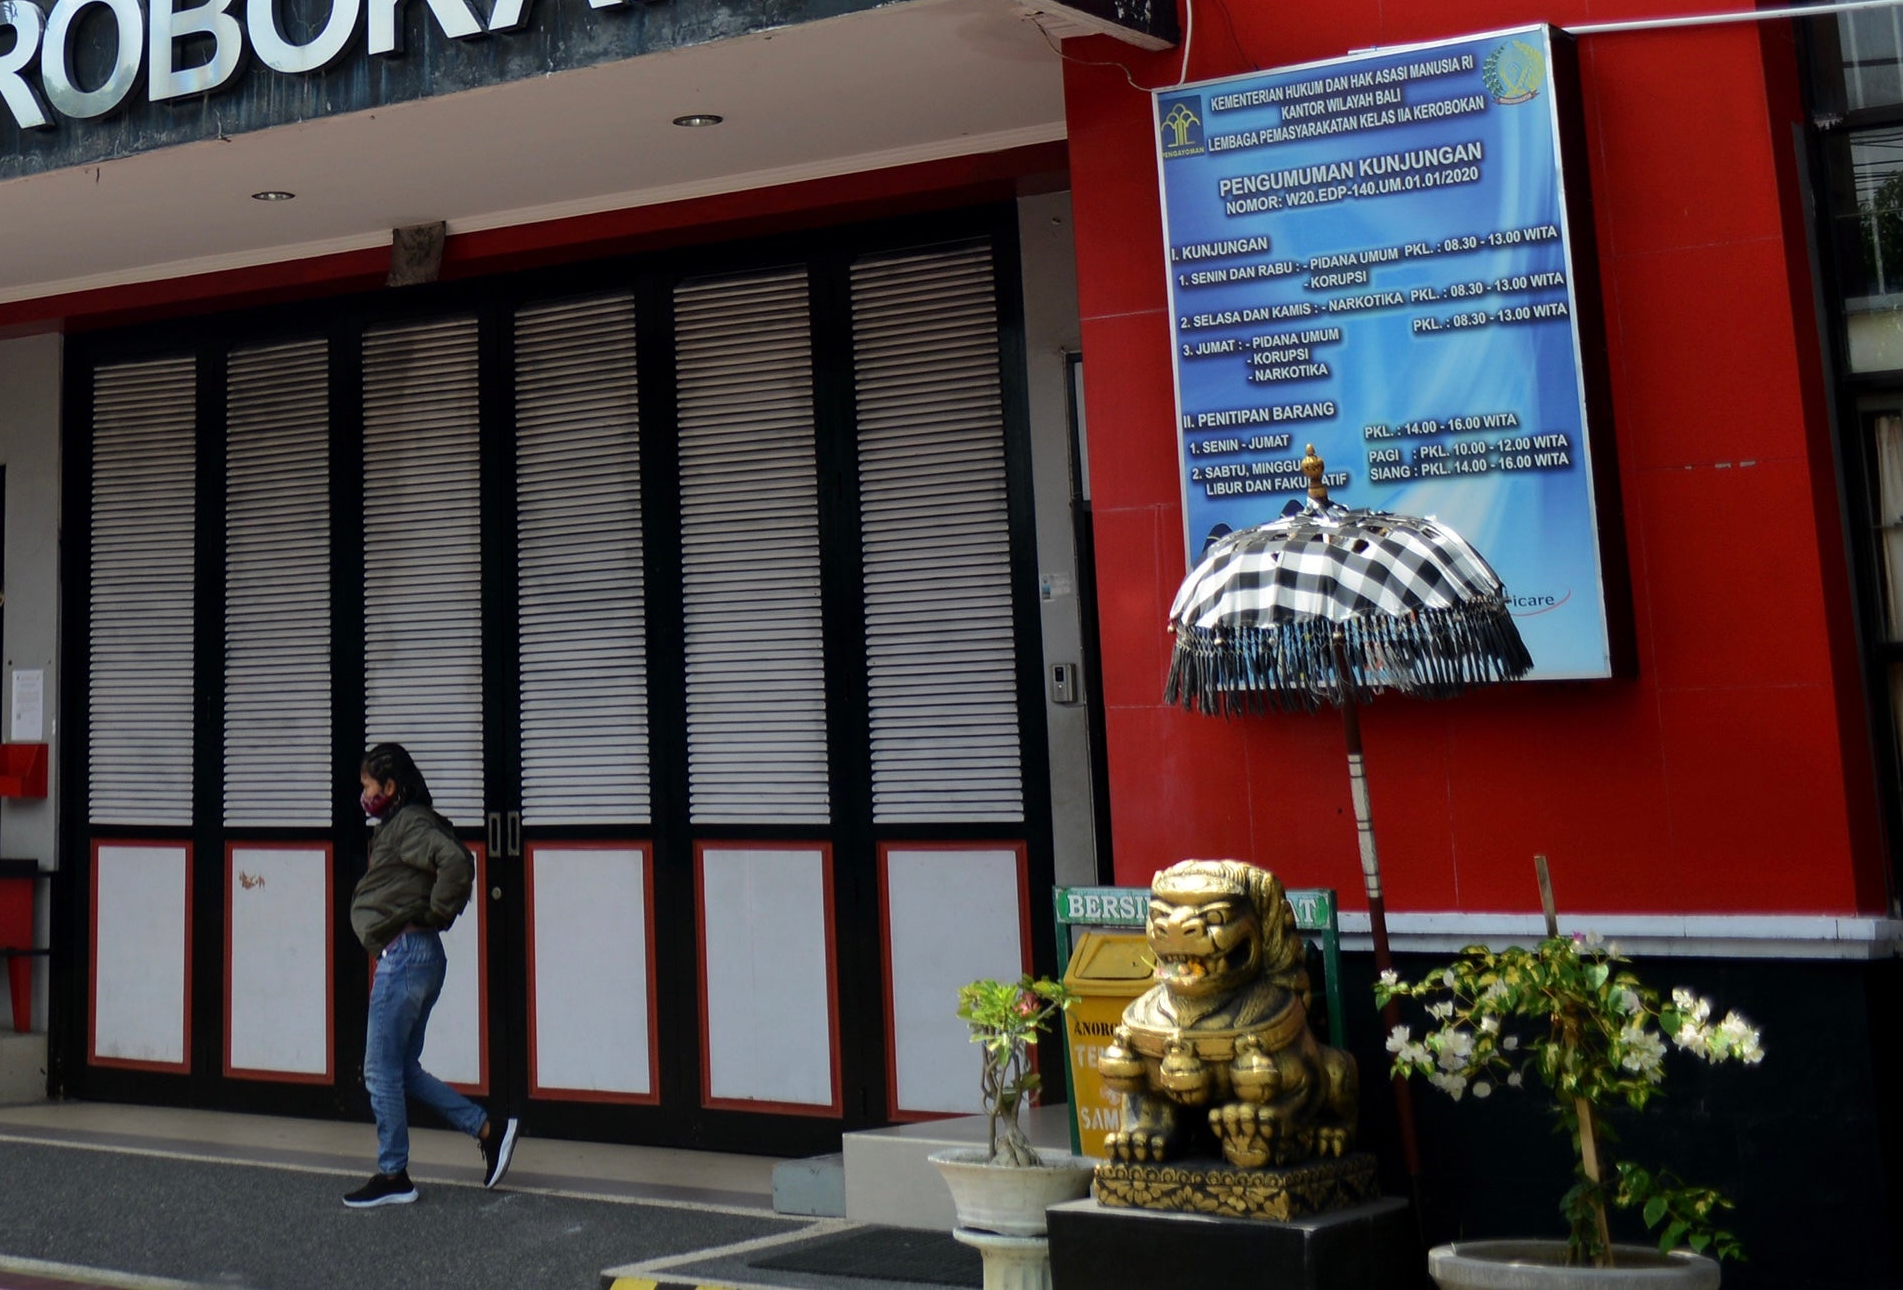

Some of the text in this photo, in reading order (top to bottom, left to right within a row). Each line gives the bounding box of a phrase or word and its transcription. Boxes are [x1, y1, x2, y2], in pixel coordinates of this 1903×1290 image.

[1211, 54, 1473, 111] KEMENTERIAN HUKUM DAN HAK ASASI MANUSIA RI
[1208, 95, 1484, 152] LEMBAGA PEMASYARAKATAN KELAS IIA KEROBOKAN
[1282, 88, 1401, 120] KANTOR WILAYAH BALI
[1220, 142, 1482, 197] PENGUMUMAN KUNJUNGAN
[1226, 166, 1479, 215] NOMOR: W20.EDP-140.UM.01.01/2020
[1171, 237, 1268, 260] I. KUNJUNGAN
[1179, 227, 1557, 286] 1. SENIN DAN RABU PIDANA UMUM PKL. 08.30 13.00 WITA
[1311, 271, 1367, 289] KORUPSI
[1181, 273, 1564, 328] 2. SELASA DAN KAMIS NARKOTIKA PKL. 08.30 13.00 WITA
[1183, 304, 1567, 356] 3. JUMAT PIDANA UMUM PKL. 08.30 13.00 WITA
[1254, 348, 1309, 364] KORUPSI
[1256, 363, 1328, 381] NARKOTIKA
[1183, 402, 1334, 428] II. PENITIPAN BARANG
[1190, 414, 1517, 454] 1. SENIN JUMAT PKL. 14.00 16.00 WITA
[1192, 468, 1202, 479] 2.
[1205, 464, 1250, 478] SABTU,
[1369, 449, 1398, 463] PAGI
[1420, 445, 1449, 458] PKL.
[1453, 442, 1485, 456] 10.00
[1498, 438, 1530, 452] 12.00
[1533, 435, 1567, 449] WITA
[1206, 482, 1242, 495] LIBUR
[1246, 480, 1271, 492] DAN
[1371, 466, 1410, 480] SIANG
[1422, 463, 1451, 476] PKL.
[1454, 460, 1486, 473] 14.00
[1499, 456, 1531, 470] 16.00
[1534, 453, 1568, 467] WITA
[1068, 894, 1152, 919] BERSI
[1075, 1044, 1106, 1068] TE
[1081, 1106, 1122, 1130] SAM
